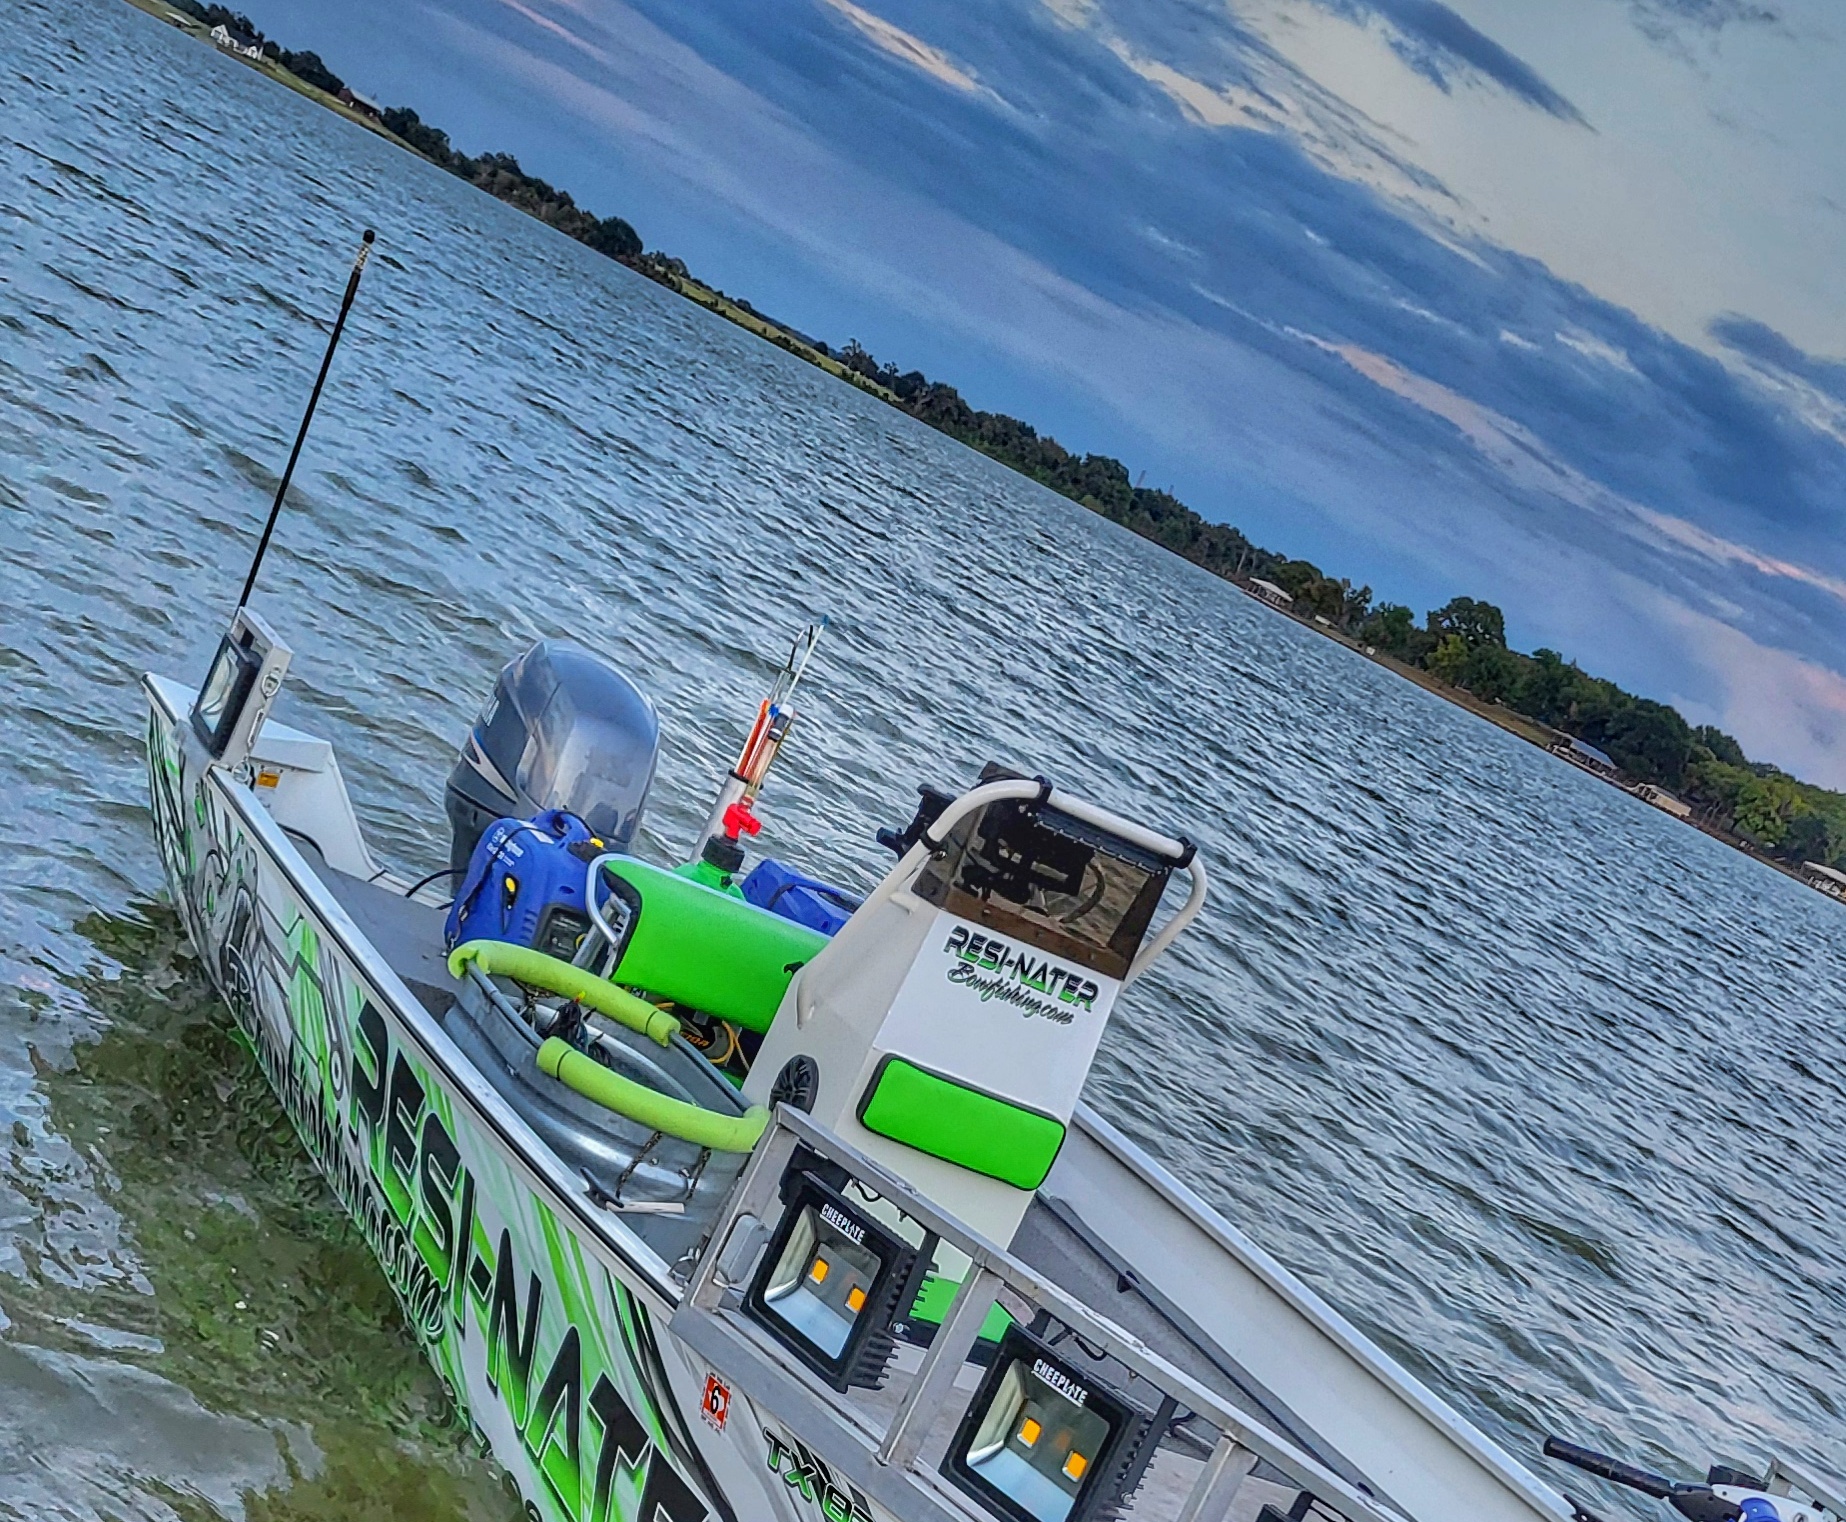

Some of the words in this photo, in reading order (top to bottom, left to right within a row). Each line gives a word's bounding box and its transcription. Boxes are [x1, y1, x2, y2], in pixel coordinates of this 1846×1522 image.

[943, 925, 1099, 1013] RESI-NATER
[947, 961, 1075, 1024] Bowfishing.com
[820, 1203, 866, 1243] CHEEPLATE
[709, 1386, 722, 1415] 6
[1033, 1358, 1089, 1405] CHEEPLATE
[764, 1427, 817, 1503] TX
